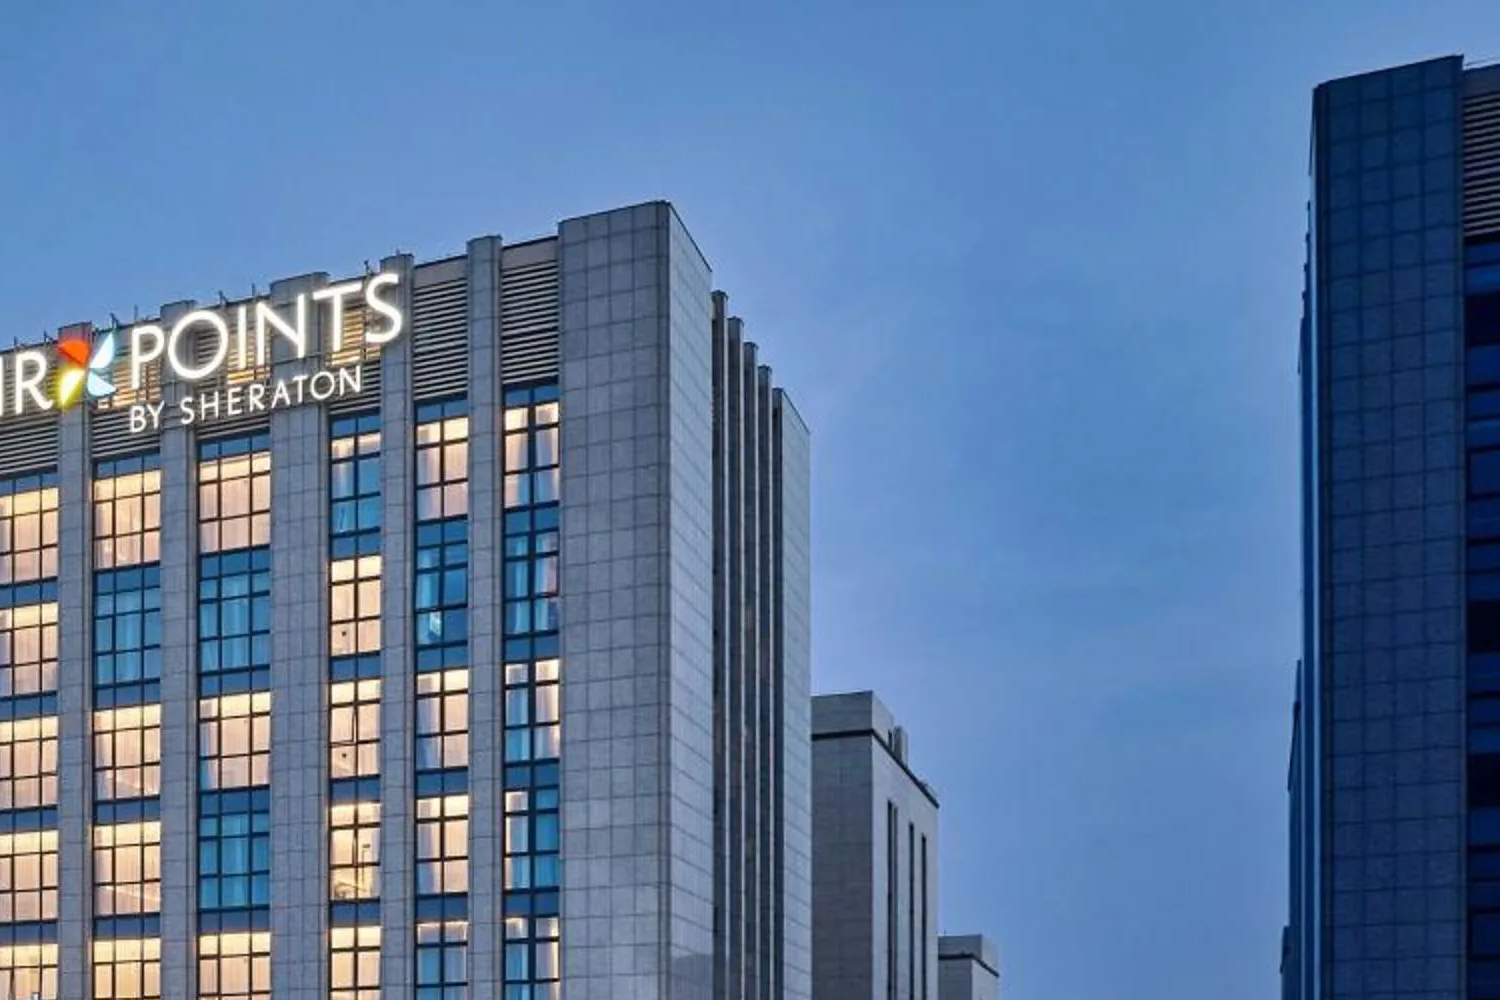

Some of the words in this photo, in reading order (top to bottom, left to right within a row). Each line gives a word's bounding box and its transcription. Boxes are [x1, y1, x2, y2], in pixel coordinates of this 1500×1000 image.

[130, 273, 402, 390] POINTS
[129, 402, 165, 433] BY
[181, 365, 361, 425] SHERATON
